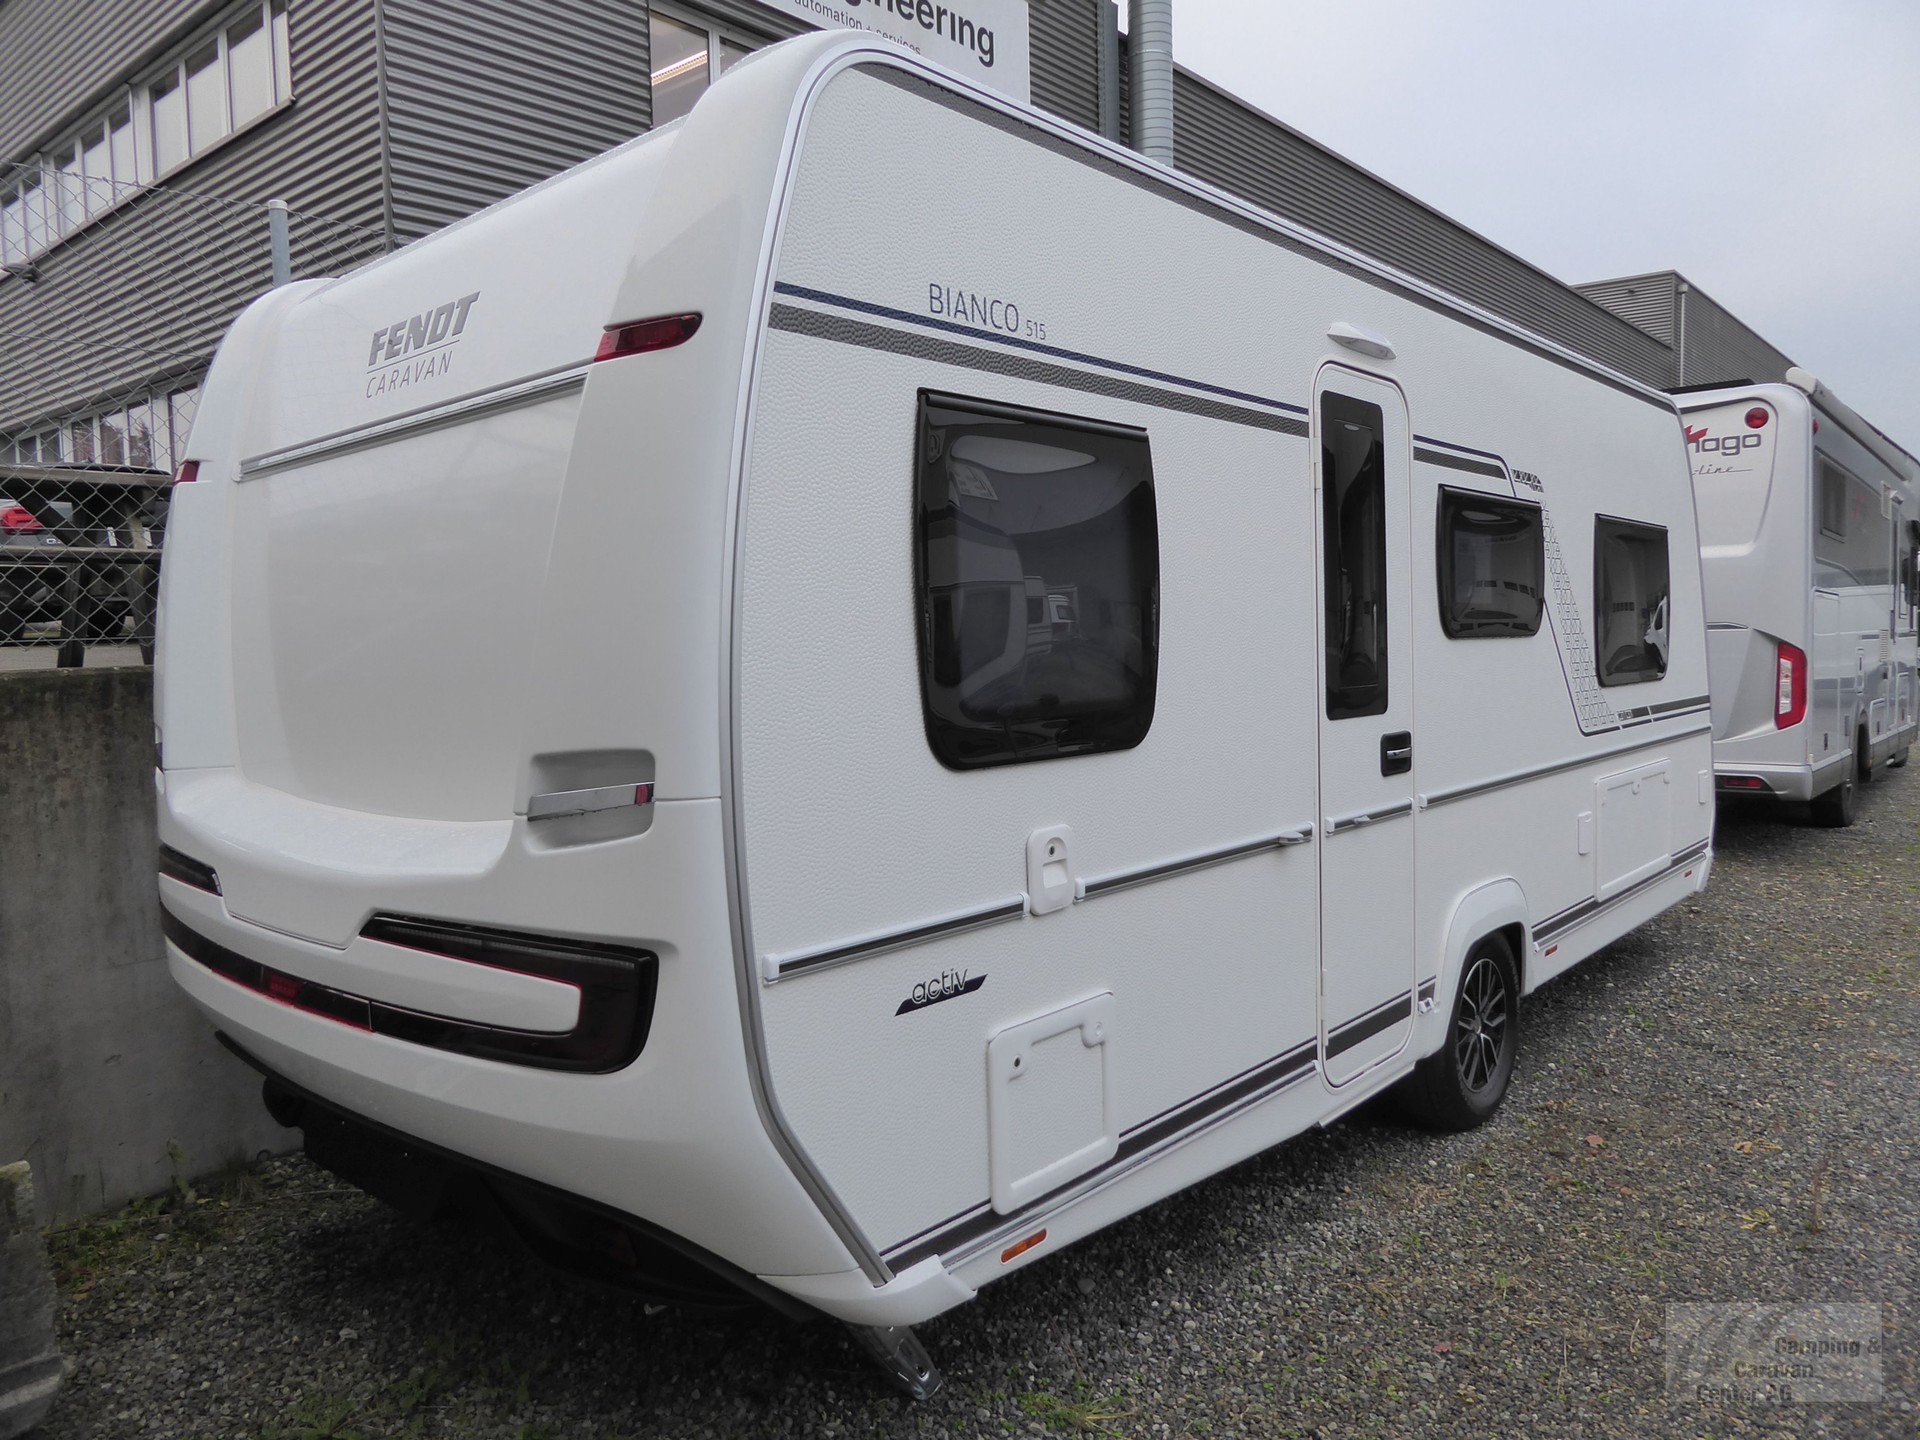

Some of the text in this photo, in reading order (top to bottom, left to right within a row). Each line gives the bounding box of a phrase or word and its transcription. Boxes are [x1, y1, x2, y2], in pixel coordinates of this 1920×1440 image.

[845, 0, 995, 68] eering
[368, 291, 481, 367] FENDT
[929, 283, 1047, 341] BIANCO 515
[365, 350, 453, 399] CARAVAN
[912, 967, 968, 1003] activ
